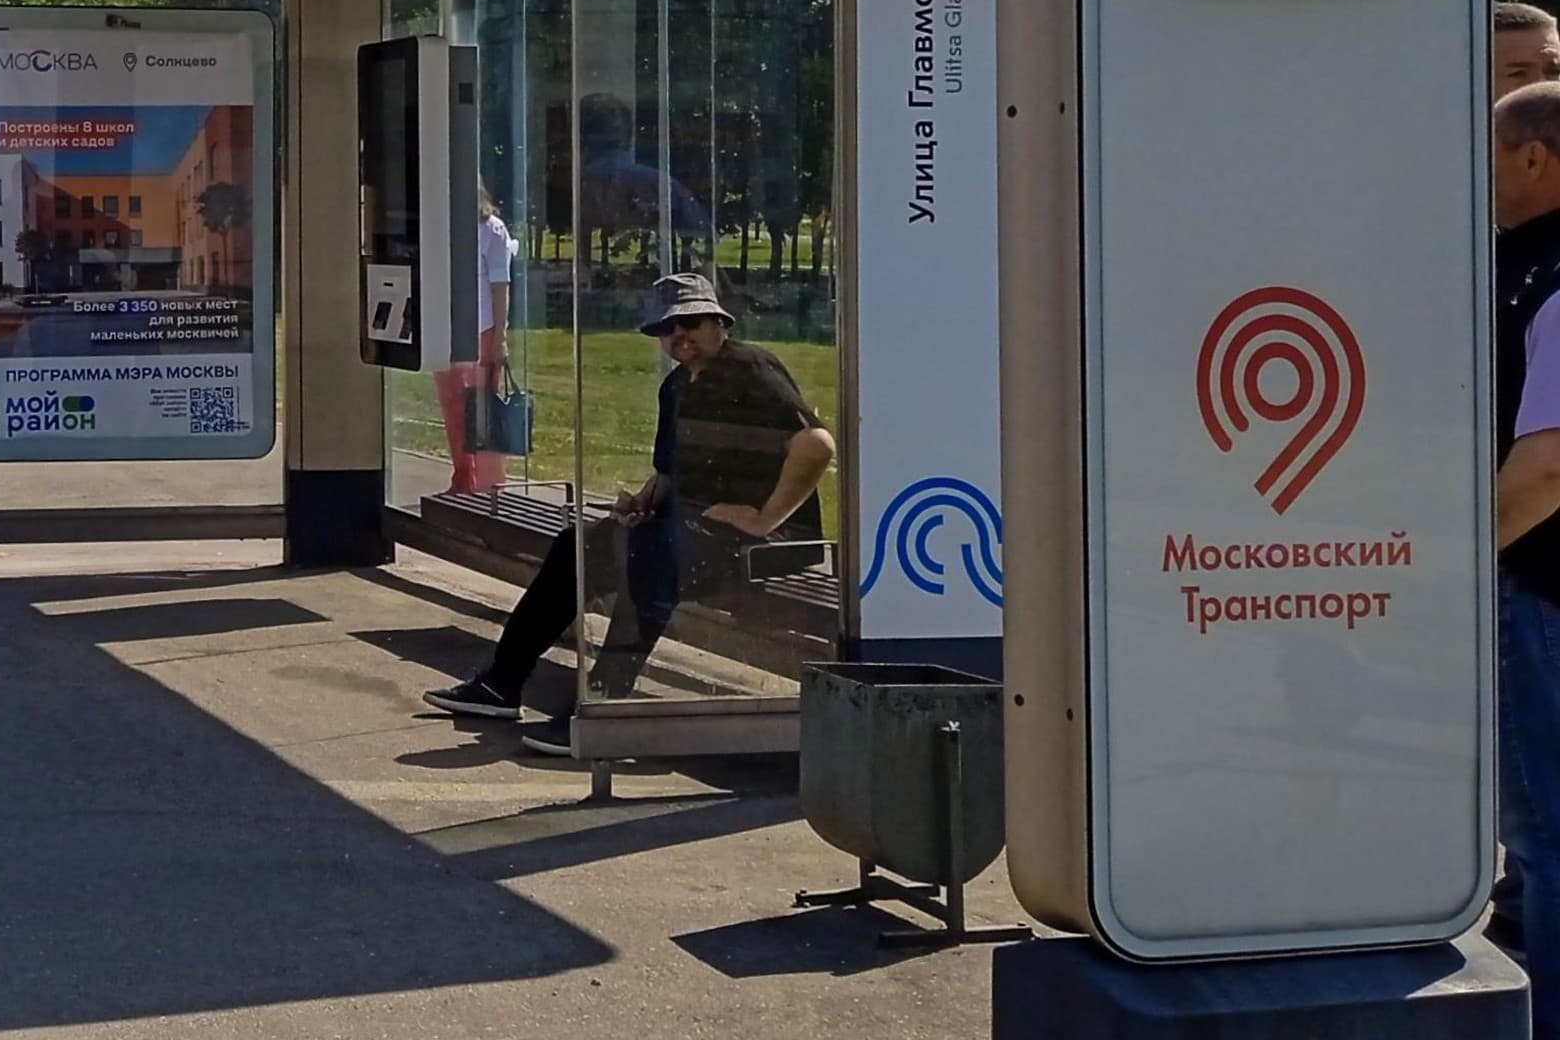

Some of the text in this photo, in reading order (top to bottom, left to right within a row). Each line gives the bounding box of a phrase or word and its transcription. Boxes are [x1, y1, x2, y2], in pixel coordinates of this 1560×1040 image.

[146, 55, 216, 69] Солнцево
[944, 36, 962, 94] Ulitsa
[83, 122, 91, 133] 8
[96, 122, 134, 134] школ
[9, 137, 68, 149] детских
[72, 137, 115, 149] садов
[909, 120, 938, 224] Улица
[73, 300, 115, 312] Более
[161, 300, 201, 311] новых
[205, 300, 238, 310] мест
[149, 314, 239, 327] для развития
[90, 326, 239, 341] маленьких москвичей
[6, 365, 239, 383] ПРОГРАММА МЭРА МОСКВЫ
[6, 390, 59, 414] мой
[1162, 530, 1412, 572] Московский
[1180, 586, 1391, 634] Транспорт
